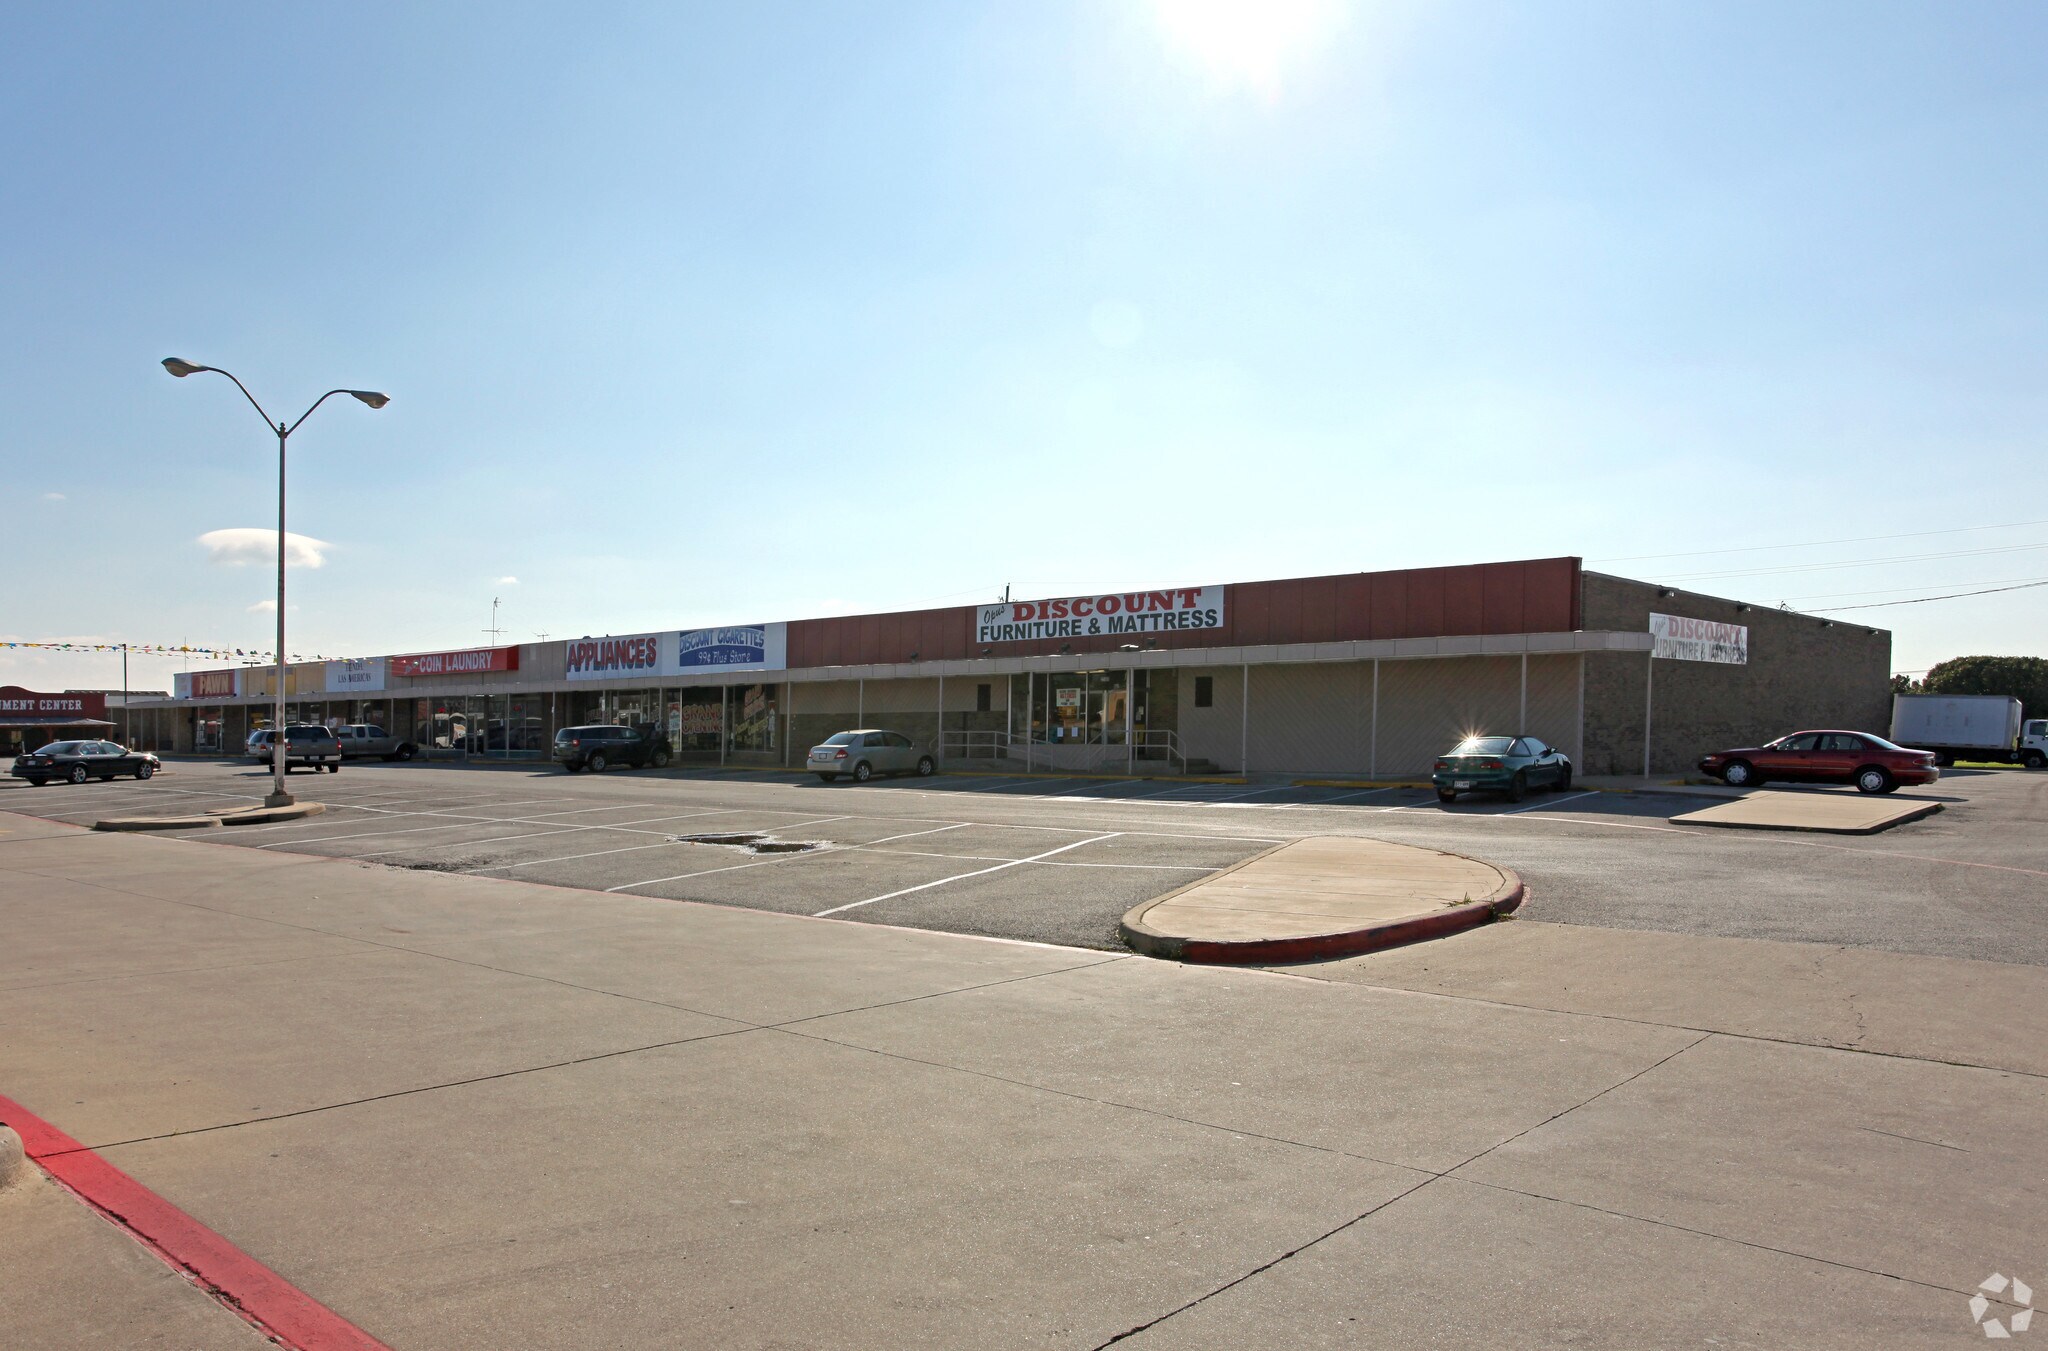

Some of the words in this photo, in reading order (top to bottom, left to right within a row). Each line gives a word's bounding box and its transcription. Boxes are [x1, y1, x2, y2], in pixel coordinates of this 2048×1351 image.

[1012, 588, 1202, 622] DISCOUNT
[980, 619, 1082, 642] FURNITURE
[1088, 618, 1101, 635] &
[1108, 608, 1218, 634] MATTRESS
[984, 607, 1006, 625] Opus
[680, 629, 714, 652] DISCOUNT
[717, 626, 764, 648] CIGARETTES
[1655, 638, 1699, 660] URNITURE
[420, 655, 442, 673] COIN
[446, 651, 493, 671] LAUNDRY
[567, 637, 657, 673] APPLIANCES
[730, 649, 751, 663] Store
[199, 674, 229, 695] PAWN
[337, 673, 347, 684] LAS
[40, 699, 82, 711] CENTER
[682, 704, 723, 722] GRAND
